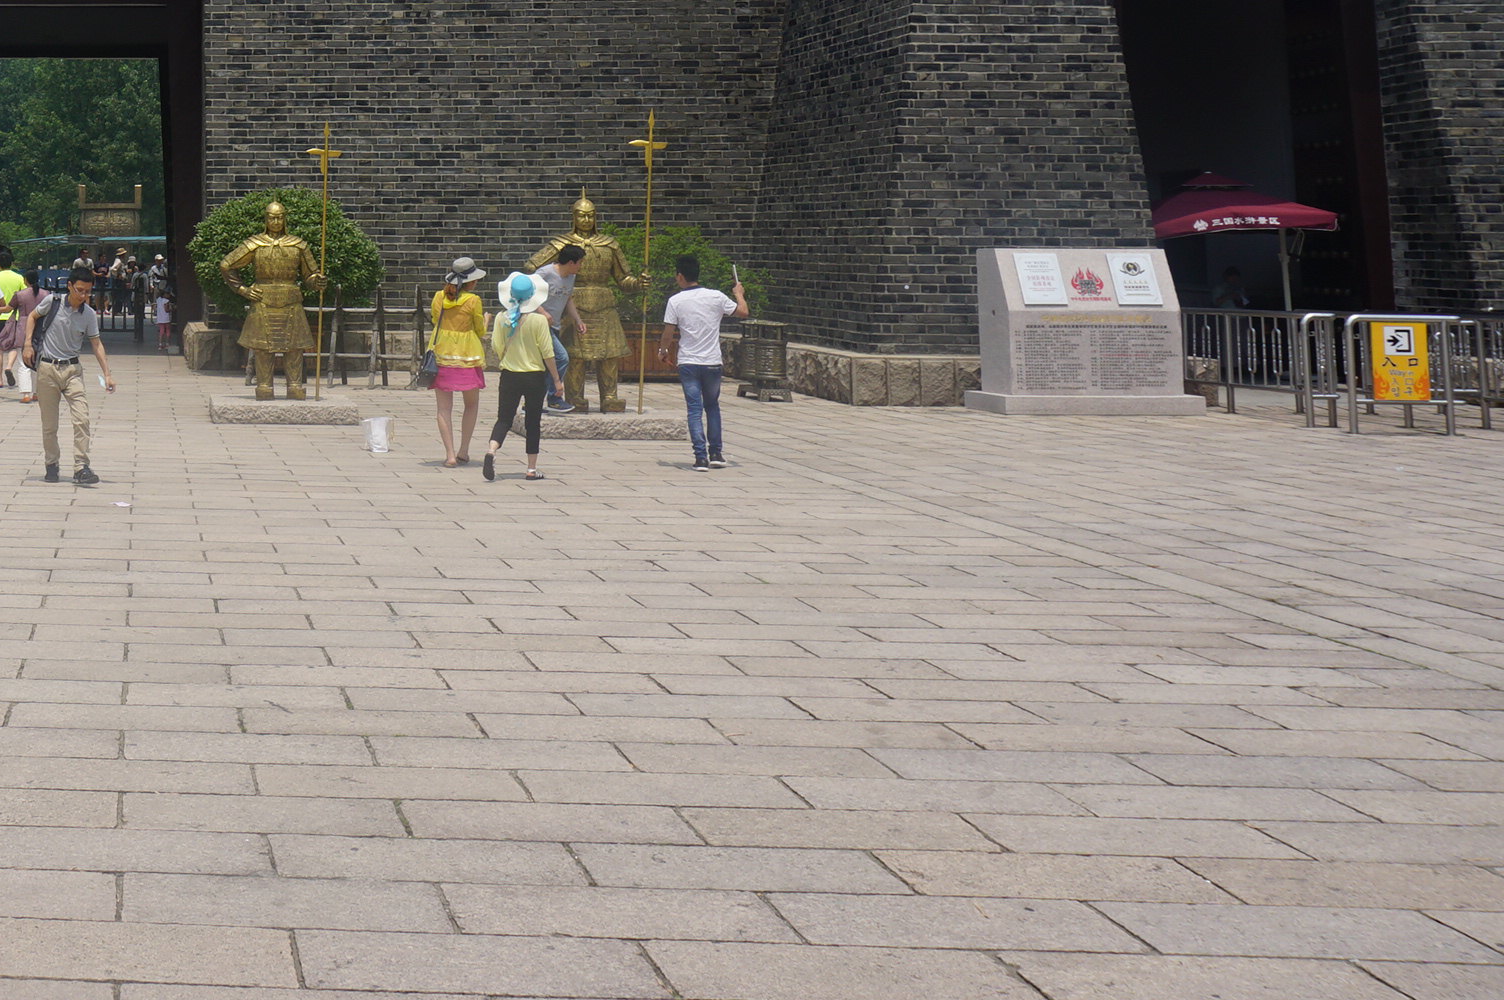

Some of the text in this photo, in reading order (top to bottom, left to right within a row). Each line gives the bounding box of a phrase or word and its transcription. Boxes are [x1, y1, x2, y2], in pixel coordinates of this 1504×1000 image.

[1211, 216, 1281, 227] 三国水浒景区
[1382, 357, 1418, 366] 入口
